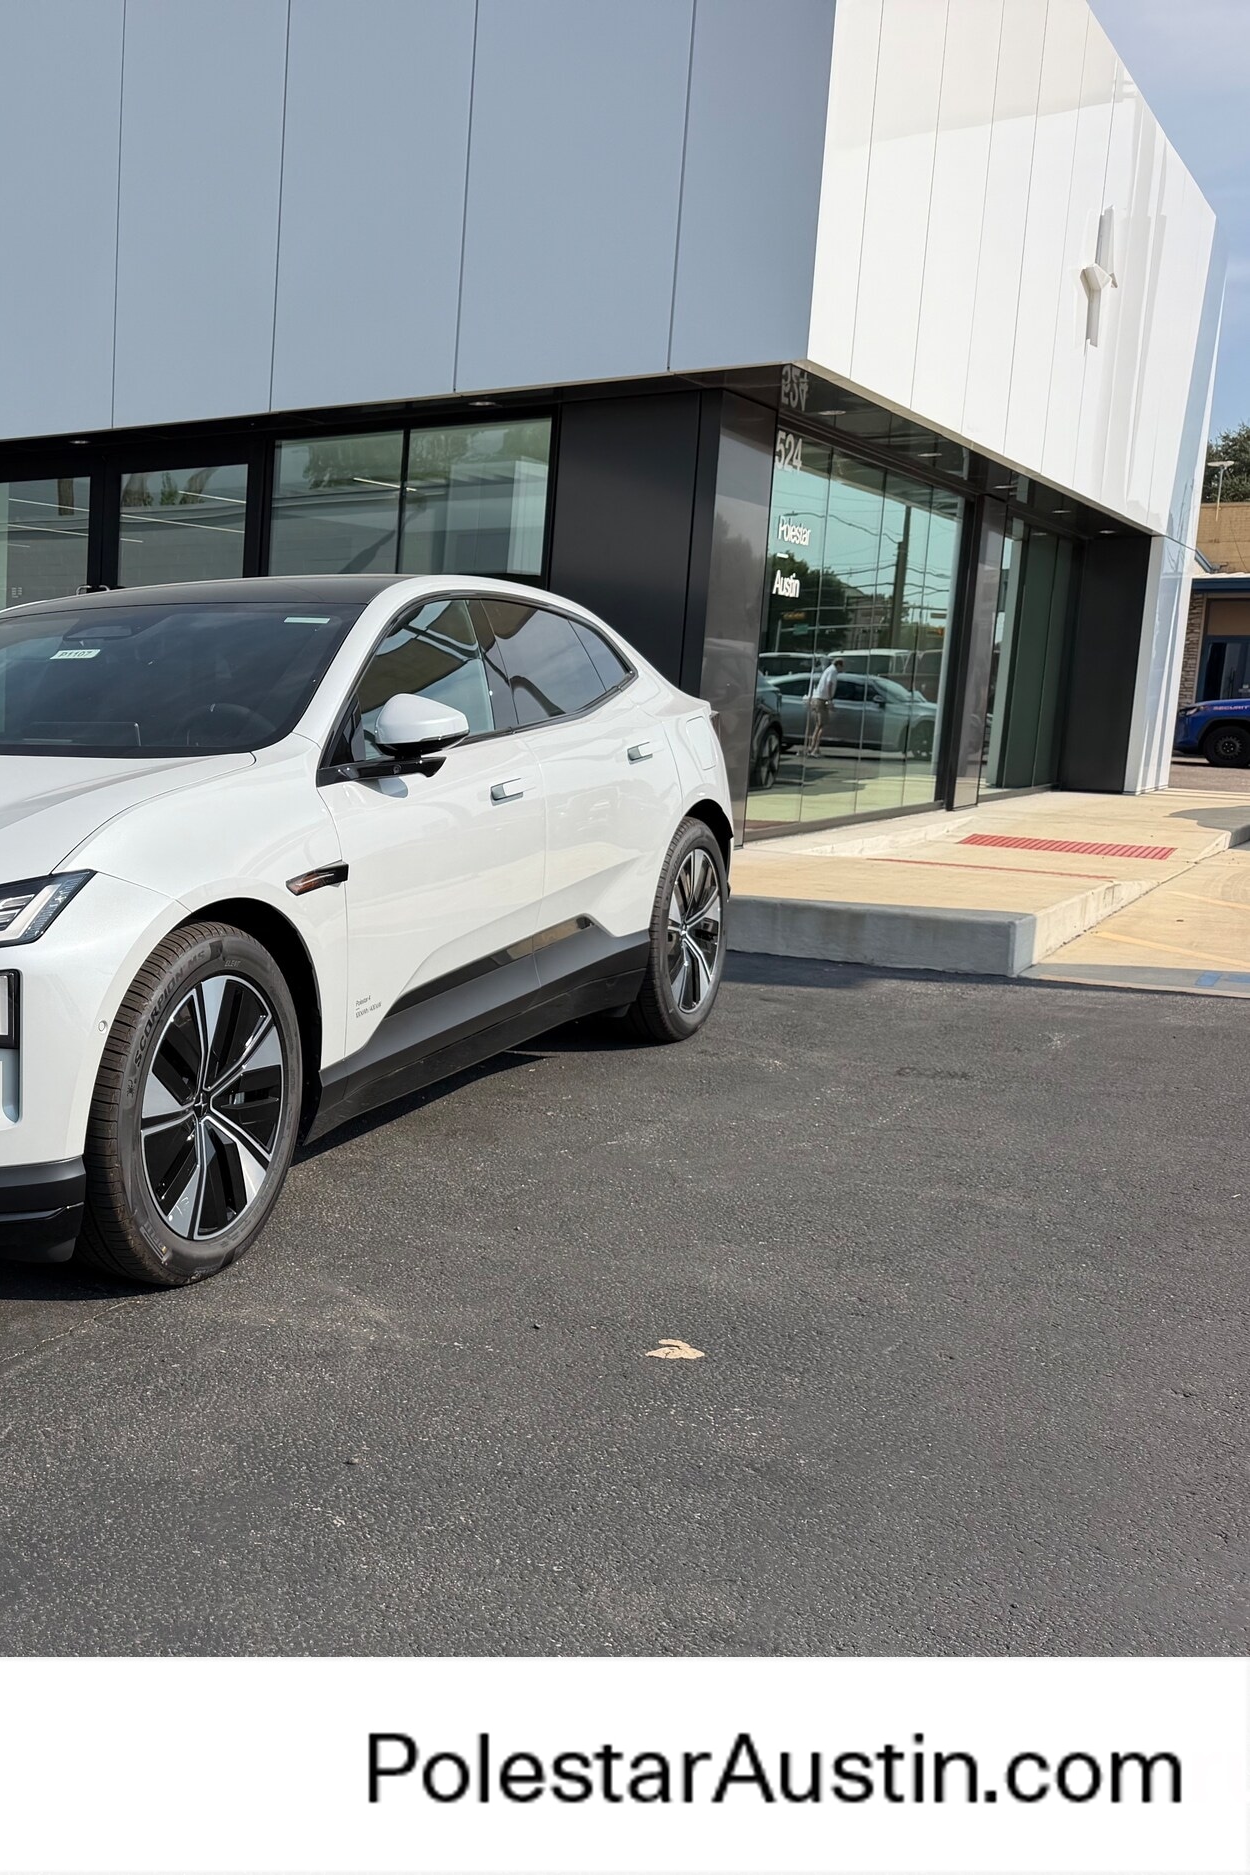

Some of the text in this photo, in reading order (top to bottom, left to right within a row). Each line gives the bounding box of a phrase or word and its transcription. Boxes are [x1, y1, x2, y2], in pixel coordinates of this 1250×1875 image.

[775, 430, 803, 474] 524
[778, 515, 812, 546] Polestar
[772, 569, 801, 598] Austin
[135, 968, 184, 1067] SCORPION
